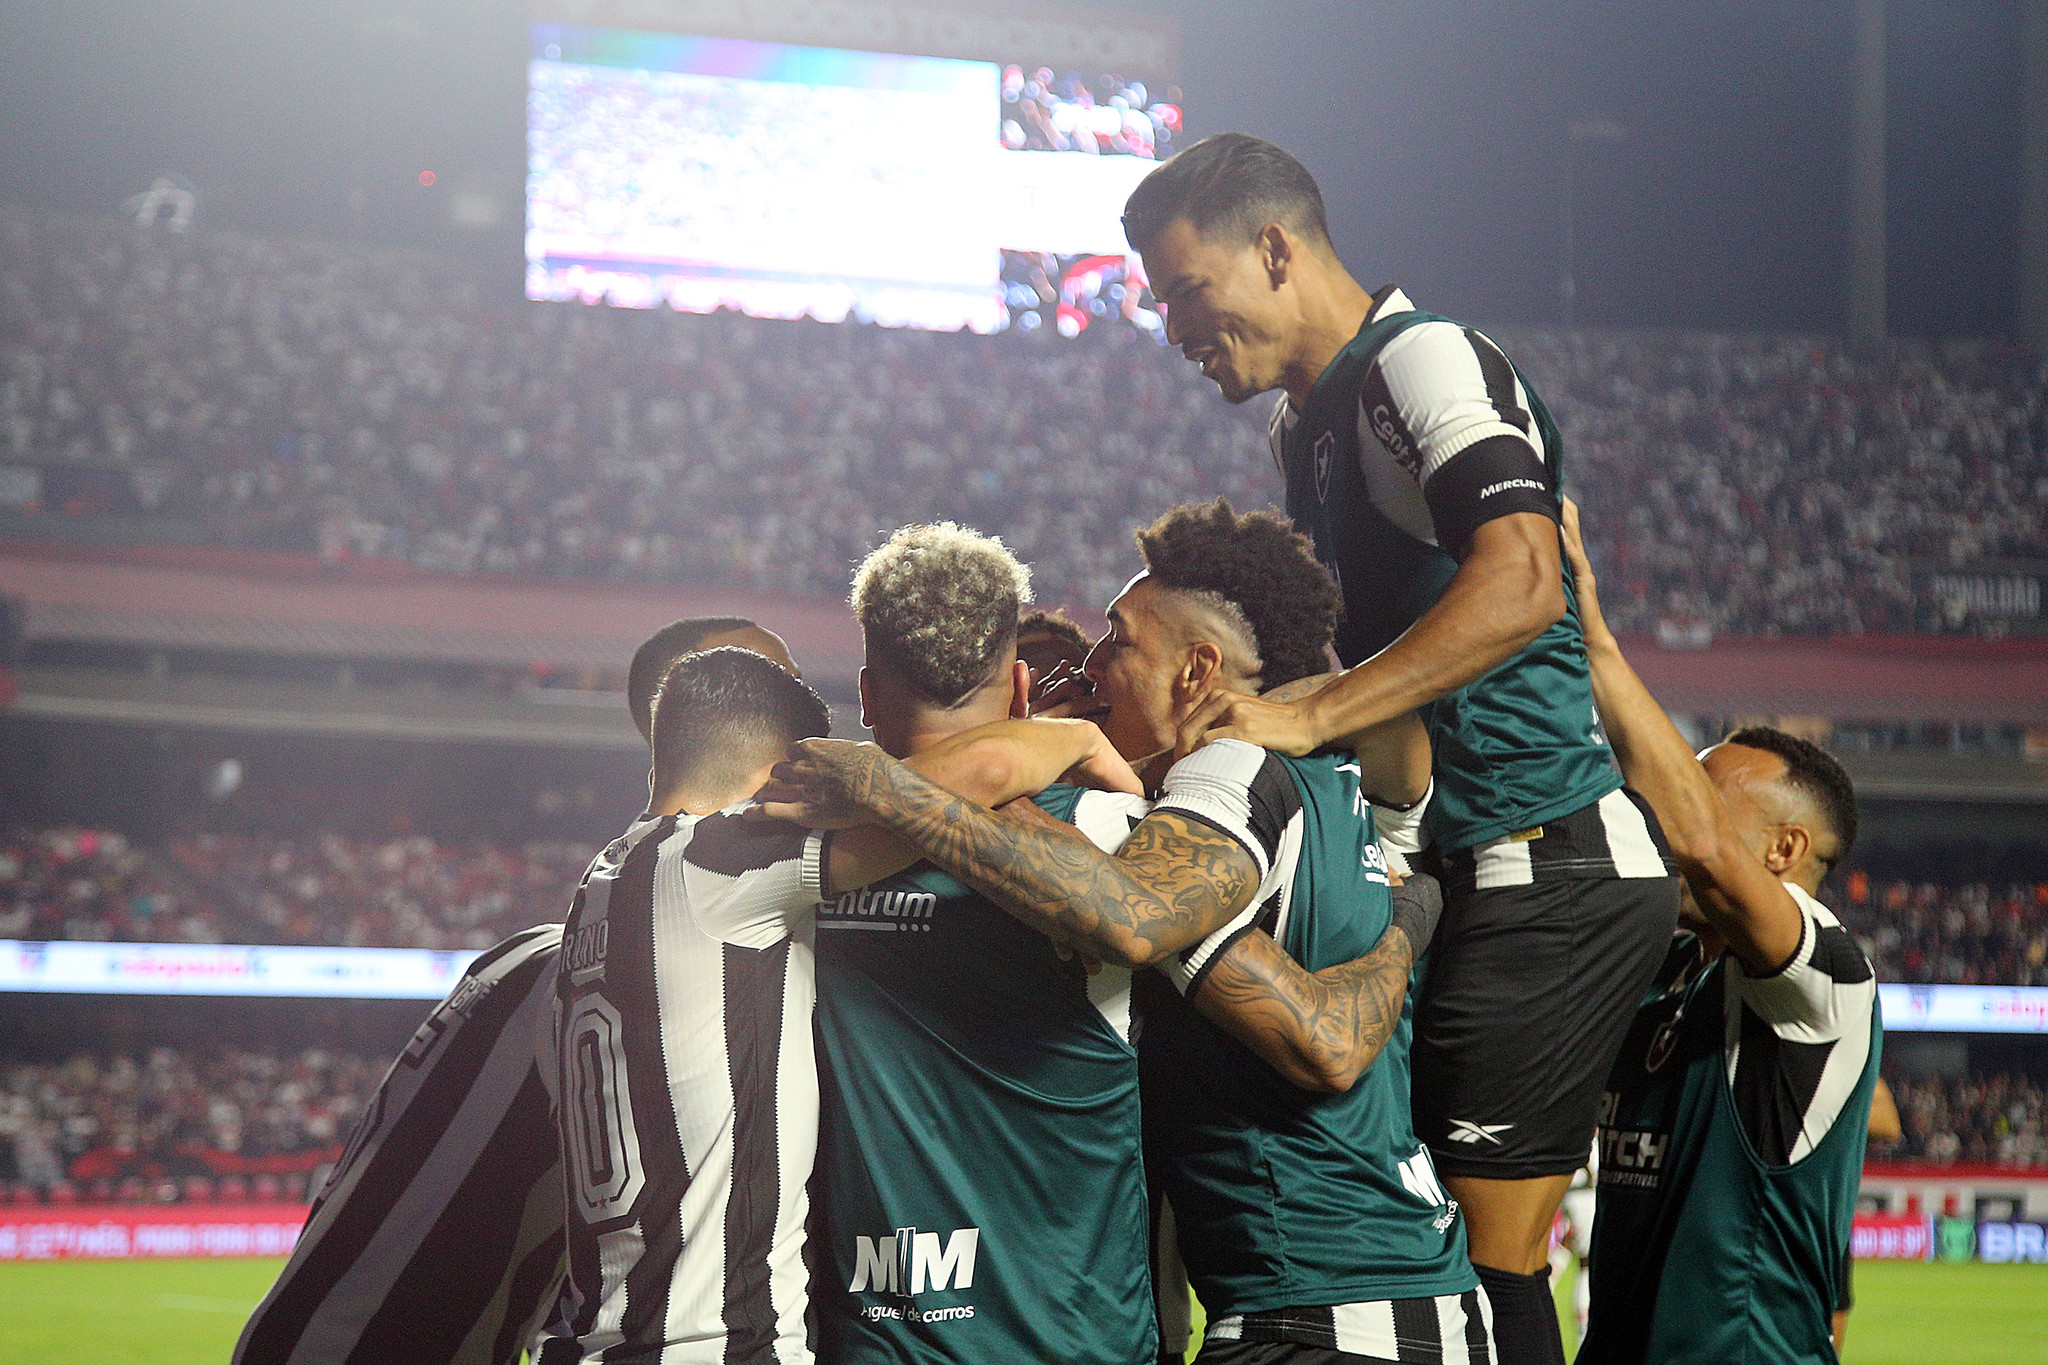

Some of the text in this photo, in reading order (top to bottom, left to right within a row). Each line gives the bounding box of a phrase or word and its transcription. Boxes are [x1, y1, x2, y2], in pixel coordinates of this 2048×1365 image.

[817, 885, 937, 918] entrum
[561, 917, 609, 973] RINO
[1600, 1129, 1669, 1170] TCH
[922, 1305, 975, 1323] carros
